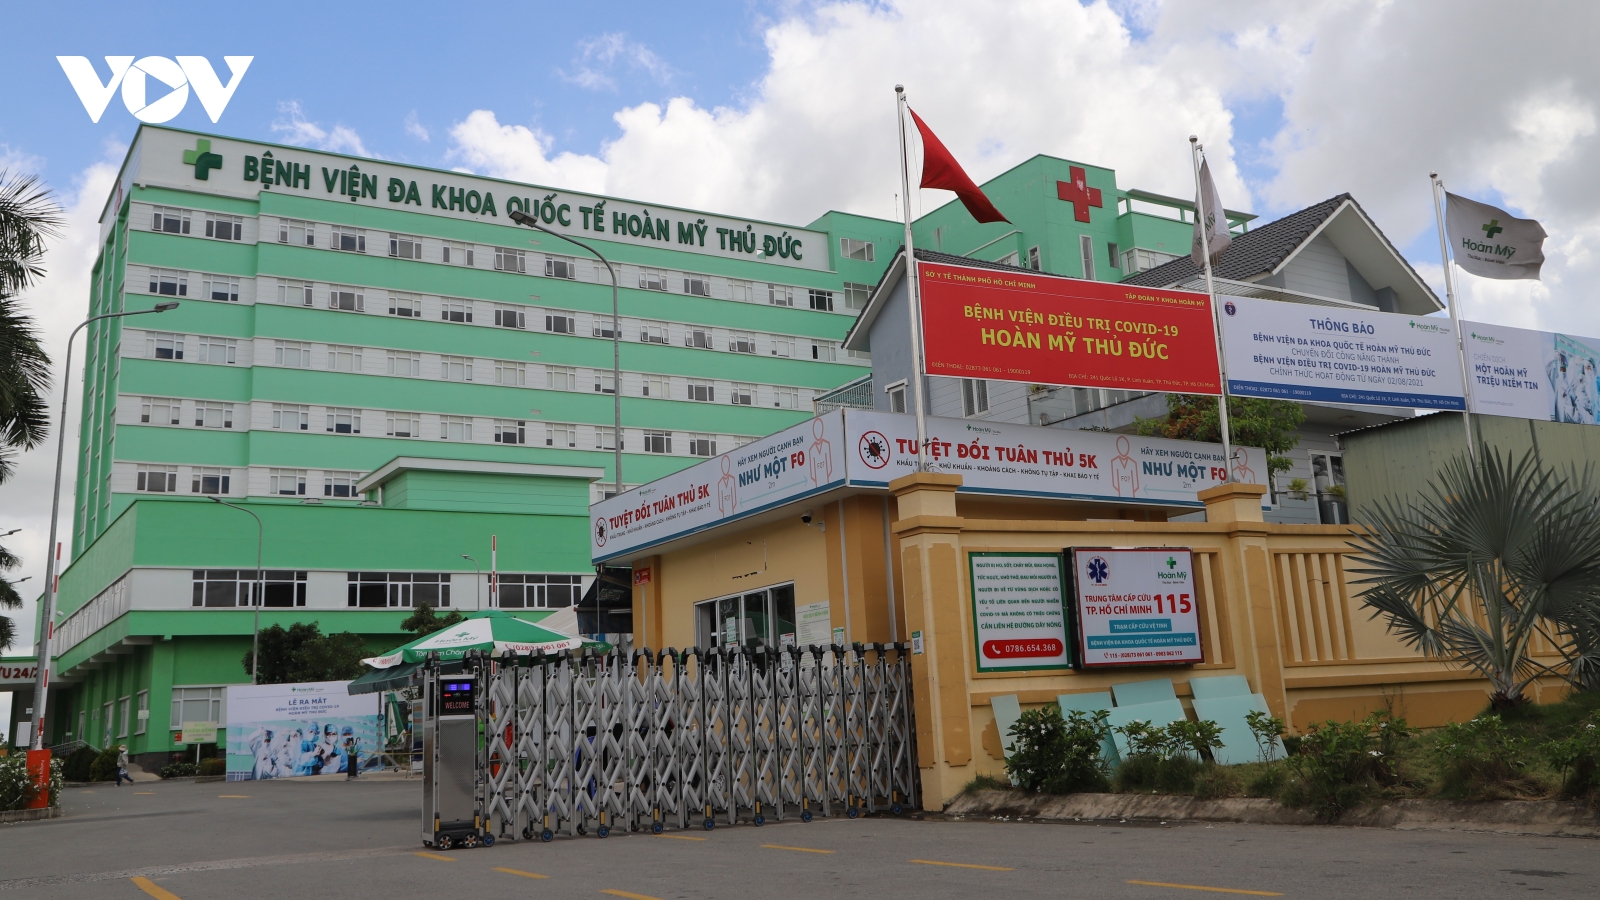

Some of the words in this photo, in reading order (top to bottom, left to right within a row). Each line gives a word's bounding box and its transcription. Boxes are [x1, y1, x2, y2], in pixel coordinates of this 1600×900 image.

[244, 150, 310, 189] BỆNH
[322, 164, 377, 202] VIỆN
[388, 178, 421, 206] ĐA
[432, 184, 497, 216] KHOA
[506, 193, 571, 226] QUỐC
[579, 200, 606, 232] TẾ
[613, 209, 670, 242] HOÀN
[678, 219, 708, 247] MỸ
[716, 224, 755, 254] THỦ
[763, 231, 803, 260] ĐỨC
[1462, 237, 1492, 254] Hoàn
[1495, 244, 1516, 259] Mỹ
[953, 274, 976, 282] THÀNH
[964, 303, 1004, 321] BỆNH
[1008, 308, 1044, 326] VIỆN
[1048, 312, 1083, 328] ĐIỀU
[1087, 317, 1110, 334] TRỊ
[1115, 320, 1179, 337] COVID-19
[1310, 318, 1349, 332] THÔNG
[1352, 321, 1374, 334] BÁO
[981, 326, 1041, 349] HOÀN
[1048, 331, 1076, 353] MỸ
[1083, 335, 1122, 356] THỦ
[1129, 338, 1169, 360] ĐỨC
[1253, 332, 1274, 343] BỆNH
[1276, 335, 1295, 345] VIỆN
[1310, 340, 1331, 348] KHOA
[1333, 340, 1353, 350] QUỐC
[1355, 342, 1364, 350] TẾ
[1366, 343, 1386, 352] HOÀN
[1388, 345, 1398, 353] MỸ
[1400, 346, 1414, 355] THỦ
[1417, 347, 1431, 356] ĐỨC
[1253, 354, 1274, 364] BỆNH
[1277, 356, 1295, 367] VIỆN
[1298, 358, 1316, 367] ĐIỀU
[1318, 361, 1331, 370] TRỊ
[1334, 362, 1368, 372] COVID-19
[1371, 364, 1391, 374] HOÀN
[1393, 366, 1404, 375] MỸ
[1405, 367, 1419, 376] THỦ
[1421, 368, 1436, 377] ĐỨC
[1292, 348, 1319, 357] CHUYỂN
[1336, 351, 1355, 360] CÔNG
[1377, 355, 1399, 364] THÀNH
[1270, 366, 1292, 376] CHÍNH
[1294, 369, 1313, 378] THỨC
[1315, 371, 1333, 381] HOẠT
[1336, 372, 1355, 382] ĐỘNG
[1357, 374, 1366, 382] TỪ
[1368, 375, 1386, 384] NGÀY
[1388, 377, 1423, 386] 02/08/2021
[1475, 363, 1491, 375] MỘT
[1494, 366, 1515, 376] HOÀN
[1517, 368, 1527, 377] MỸ
[1476, 375, 1500, 387] TRIỆU
[1524, 381, 1538, 390] TIN
[737, 457, 747, 467] HÃY
[748, 454, 757, 464] XEM
[759, 446, 776, 459] NGƯỜI
[777, 440, 791, 452] CẠNH
[793, 436, 804, 446] BẠN
[957, 437, 990, 460] ĐỐI
[995, 444, 1037, 464] TUÂN
[1042, 447, 1074, 467] THỦ
[1079, 453, 1098, 469] 5K
[1141, 446, 1153, 455] HÃY
[1155, 448, 1169, 457] XEM
[1171, 449, 1192, 458] NGƯỜI
[1194, 452, 1212, 462] CẠNH
[1213, 454, 1225, 464] BẠN
[739, 464, 761, 487] NHƯ
[764, 456, 787, 479] MỘT
[1142, 461, 1172, 477] NHƯ
[1178, 461, 1206, 482] MỘT
[609, 509, 633, 530] TUYỆT
[635, 500, 650, 521] ĐỐI
[653, 495, 675, 515] TUÂN
[677, 484, 695, 506] THỦ
[698, 483, 710, 499] 5K
[1177, 572, 1187, 580] Mỹ
[1086, 606, 1098, 615] TP.
[1099, 604, 1112, 615] HỒ
[1113, 604, 1127, 614] CHÍ
[1130, 605, 1152, 614] MINH
[1108, 594, 1122, 602] TÂM
[1123, 593, 1136, 602] CẤP
[1137, 593, 1151, 601] CỨU
[1154, 594, 1191, 614] 115
[1007, 622, 1014, 630] HỆ
[1005, 644, 1056, 652] 0786.654.368
